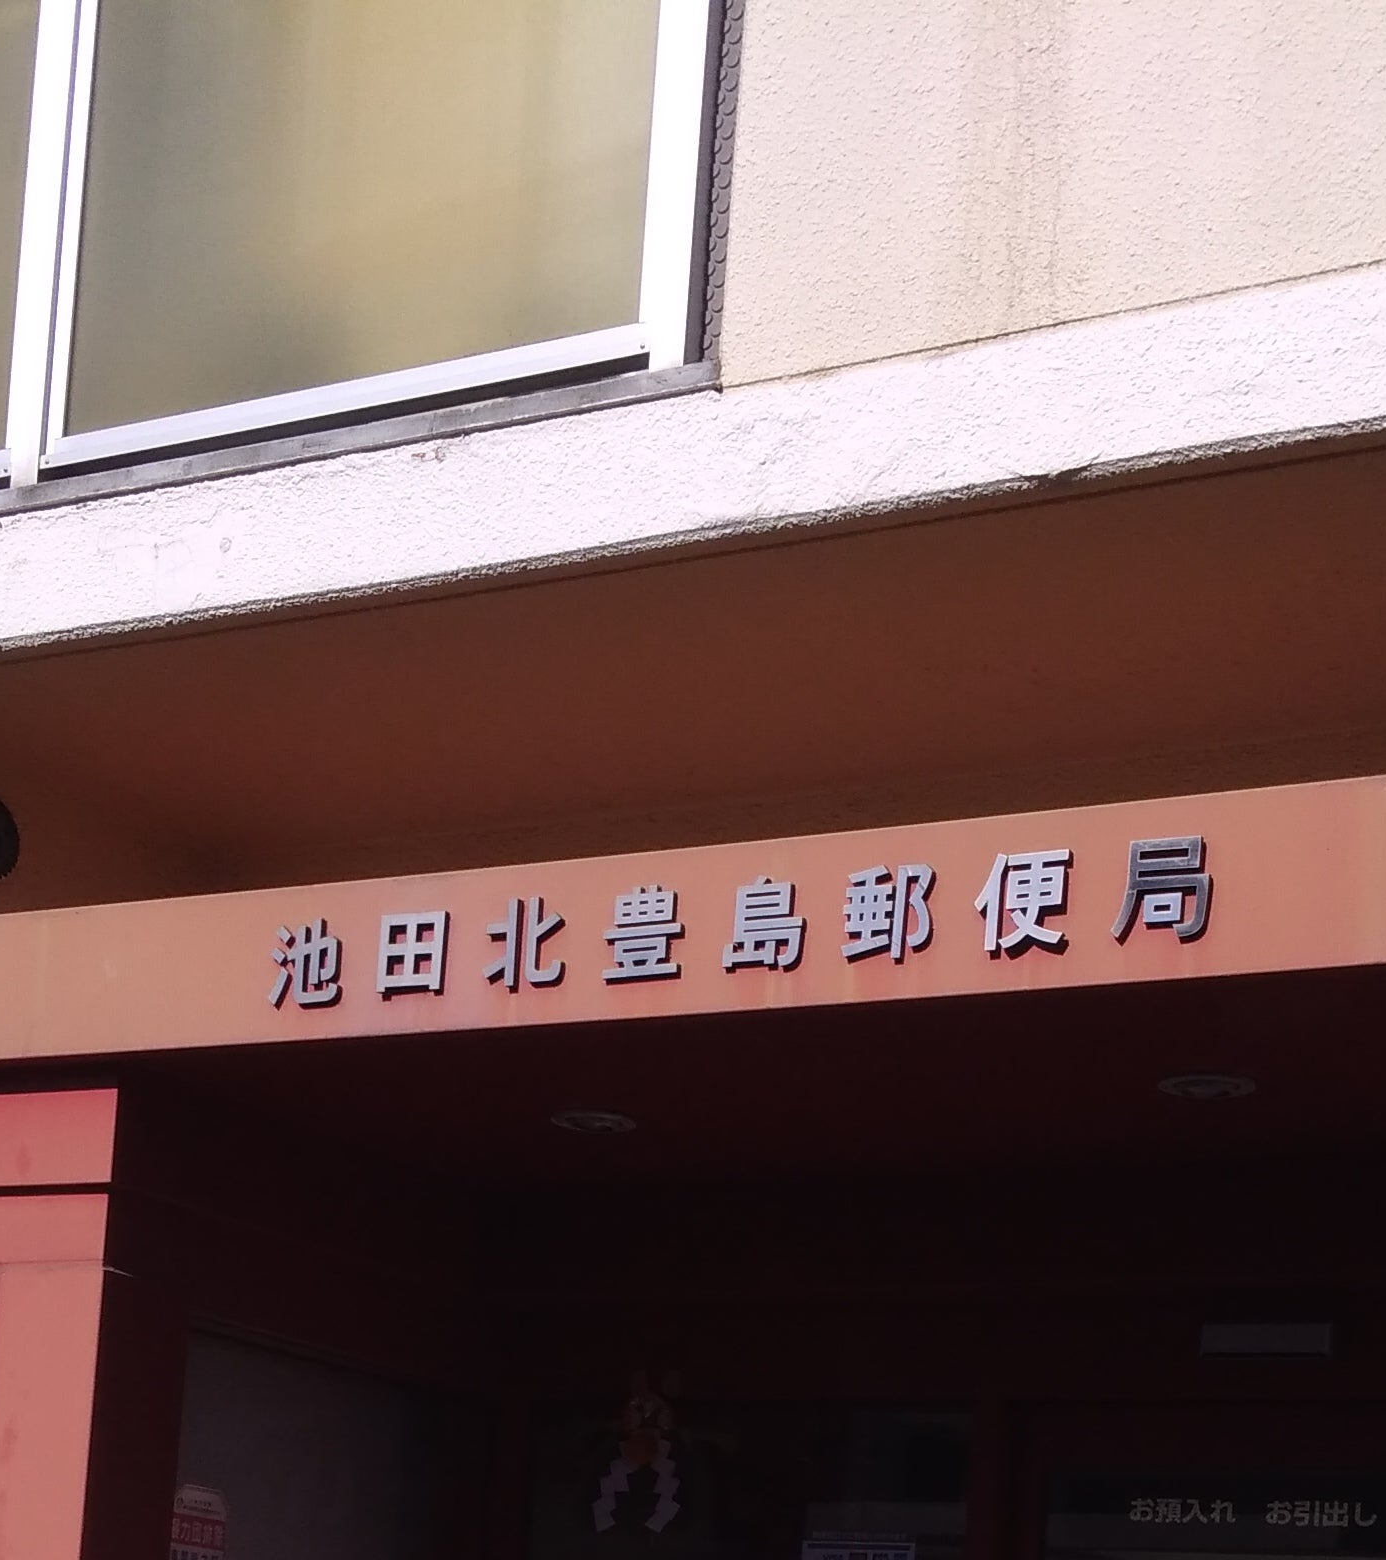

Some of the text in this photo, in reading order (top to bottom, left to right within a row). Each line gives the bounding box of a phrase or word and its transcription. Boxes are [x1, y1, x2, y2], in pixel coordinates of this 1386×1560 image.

[267, 834, 1213, 1009] 池田北豊島郵便局
[1128, 1497, 1237, 1525] お預入れ
[1265, 1500, 1378, 1529] お引出し
